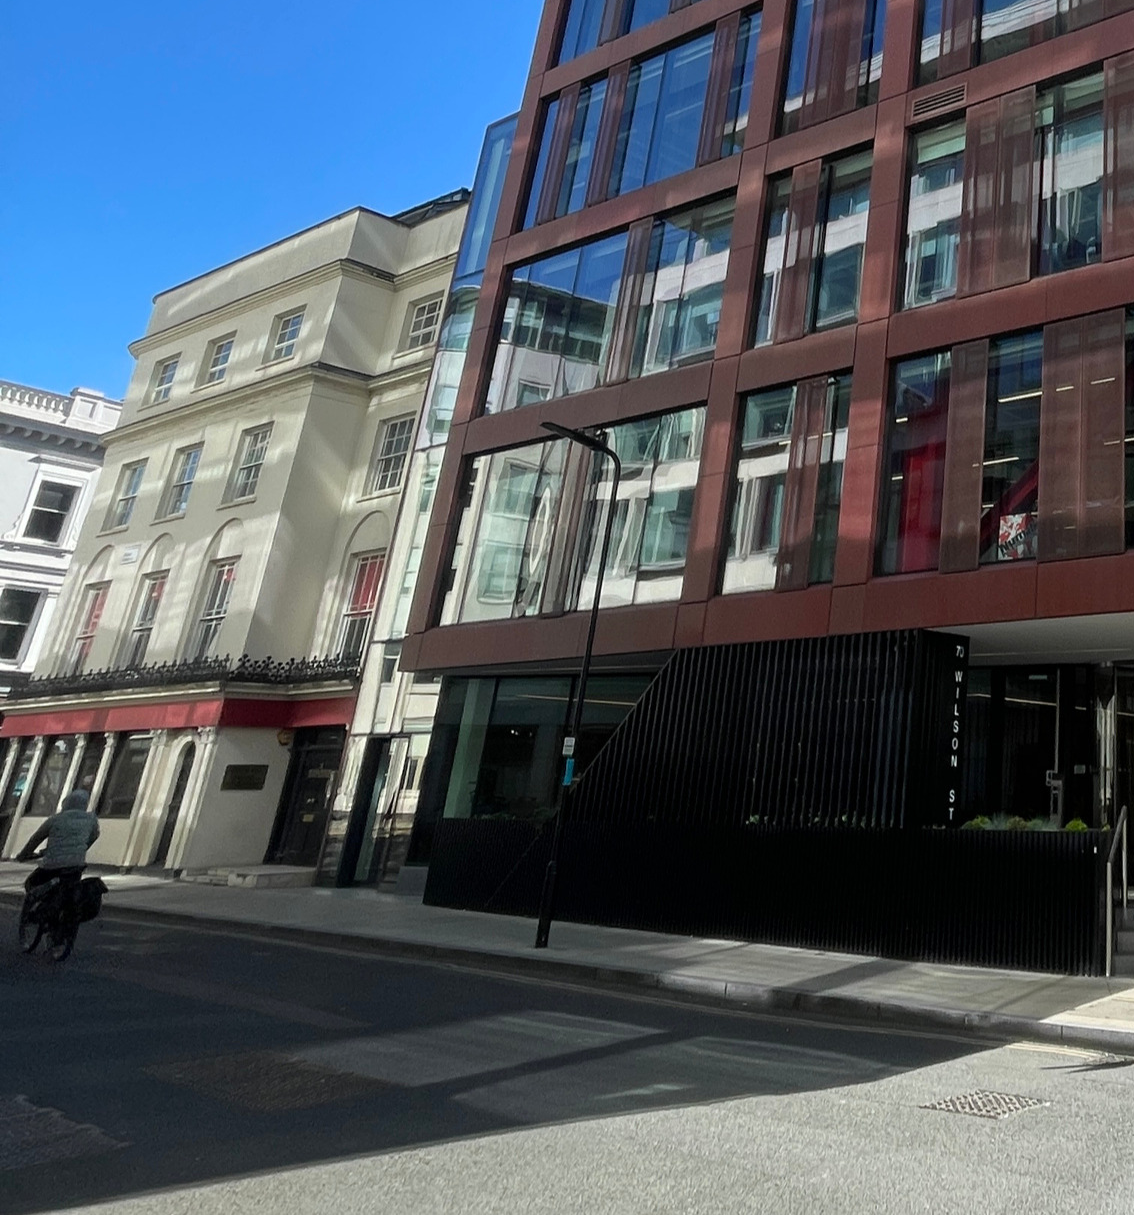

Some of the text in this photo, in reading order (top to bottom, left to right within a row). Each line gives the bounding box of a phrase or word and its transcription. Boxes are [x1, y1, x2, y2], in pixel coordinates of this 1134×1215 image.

[949, 645, 965, 820] 70 WILSON ST
